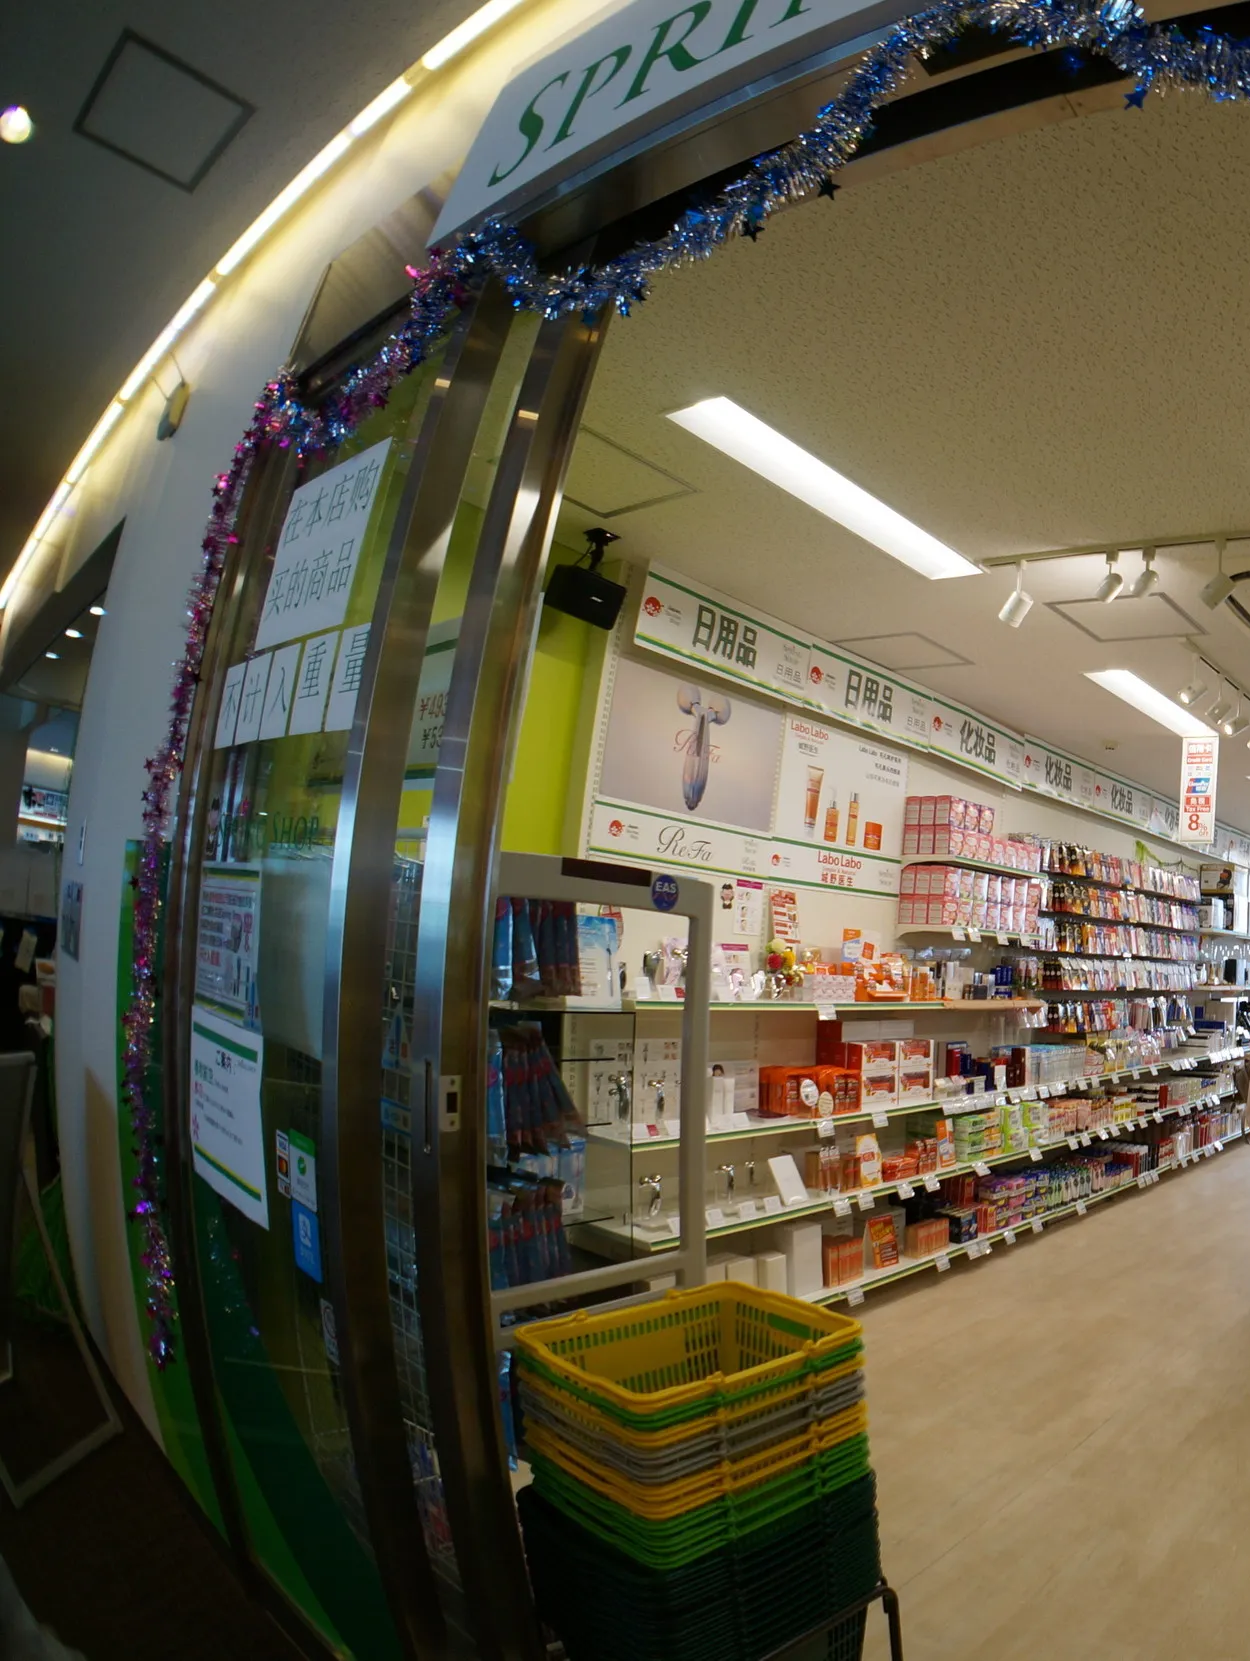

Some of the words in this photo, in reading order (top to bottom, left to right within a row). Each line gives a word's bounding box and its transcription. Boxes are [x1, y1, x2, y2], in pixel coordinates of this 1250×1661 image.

[488, 0, 812, 187] SPRI
[284, 459, 379, 548] 在本店购
[266, 539, 355, 620] 买的商品
[692, 604, 757, 670] 日用品
[223, 632, 369, 731] 不计入重量
[845, 669, 893, 724] 日用品
[790, 720, 809, 734] Labo
[811, 725, 829, 741] Labo
[959, 719, 996, 765] 化妆品
[1045, 754, 1072, 791] 化妆品
[1111, 784, 1133, 815] 化妆品
[270, 812, 319, 852] SHOP
[656, 825, 713, 863] ReFa
[817, 850, 840, 866] Labo
[840, 854, 862, 870] Labo
[821, 872, 854, 887] 城野医生
[655, 881, 676, 894] EAS
